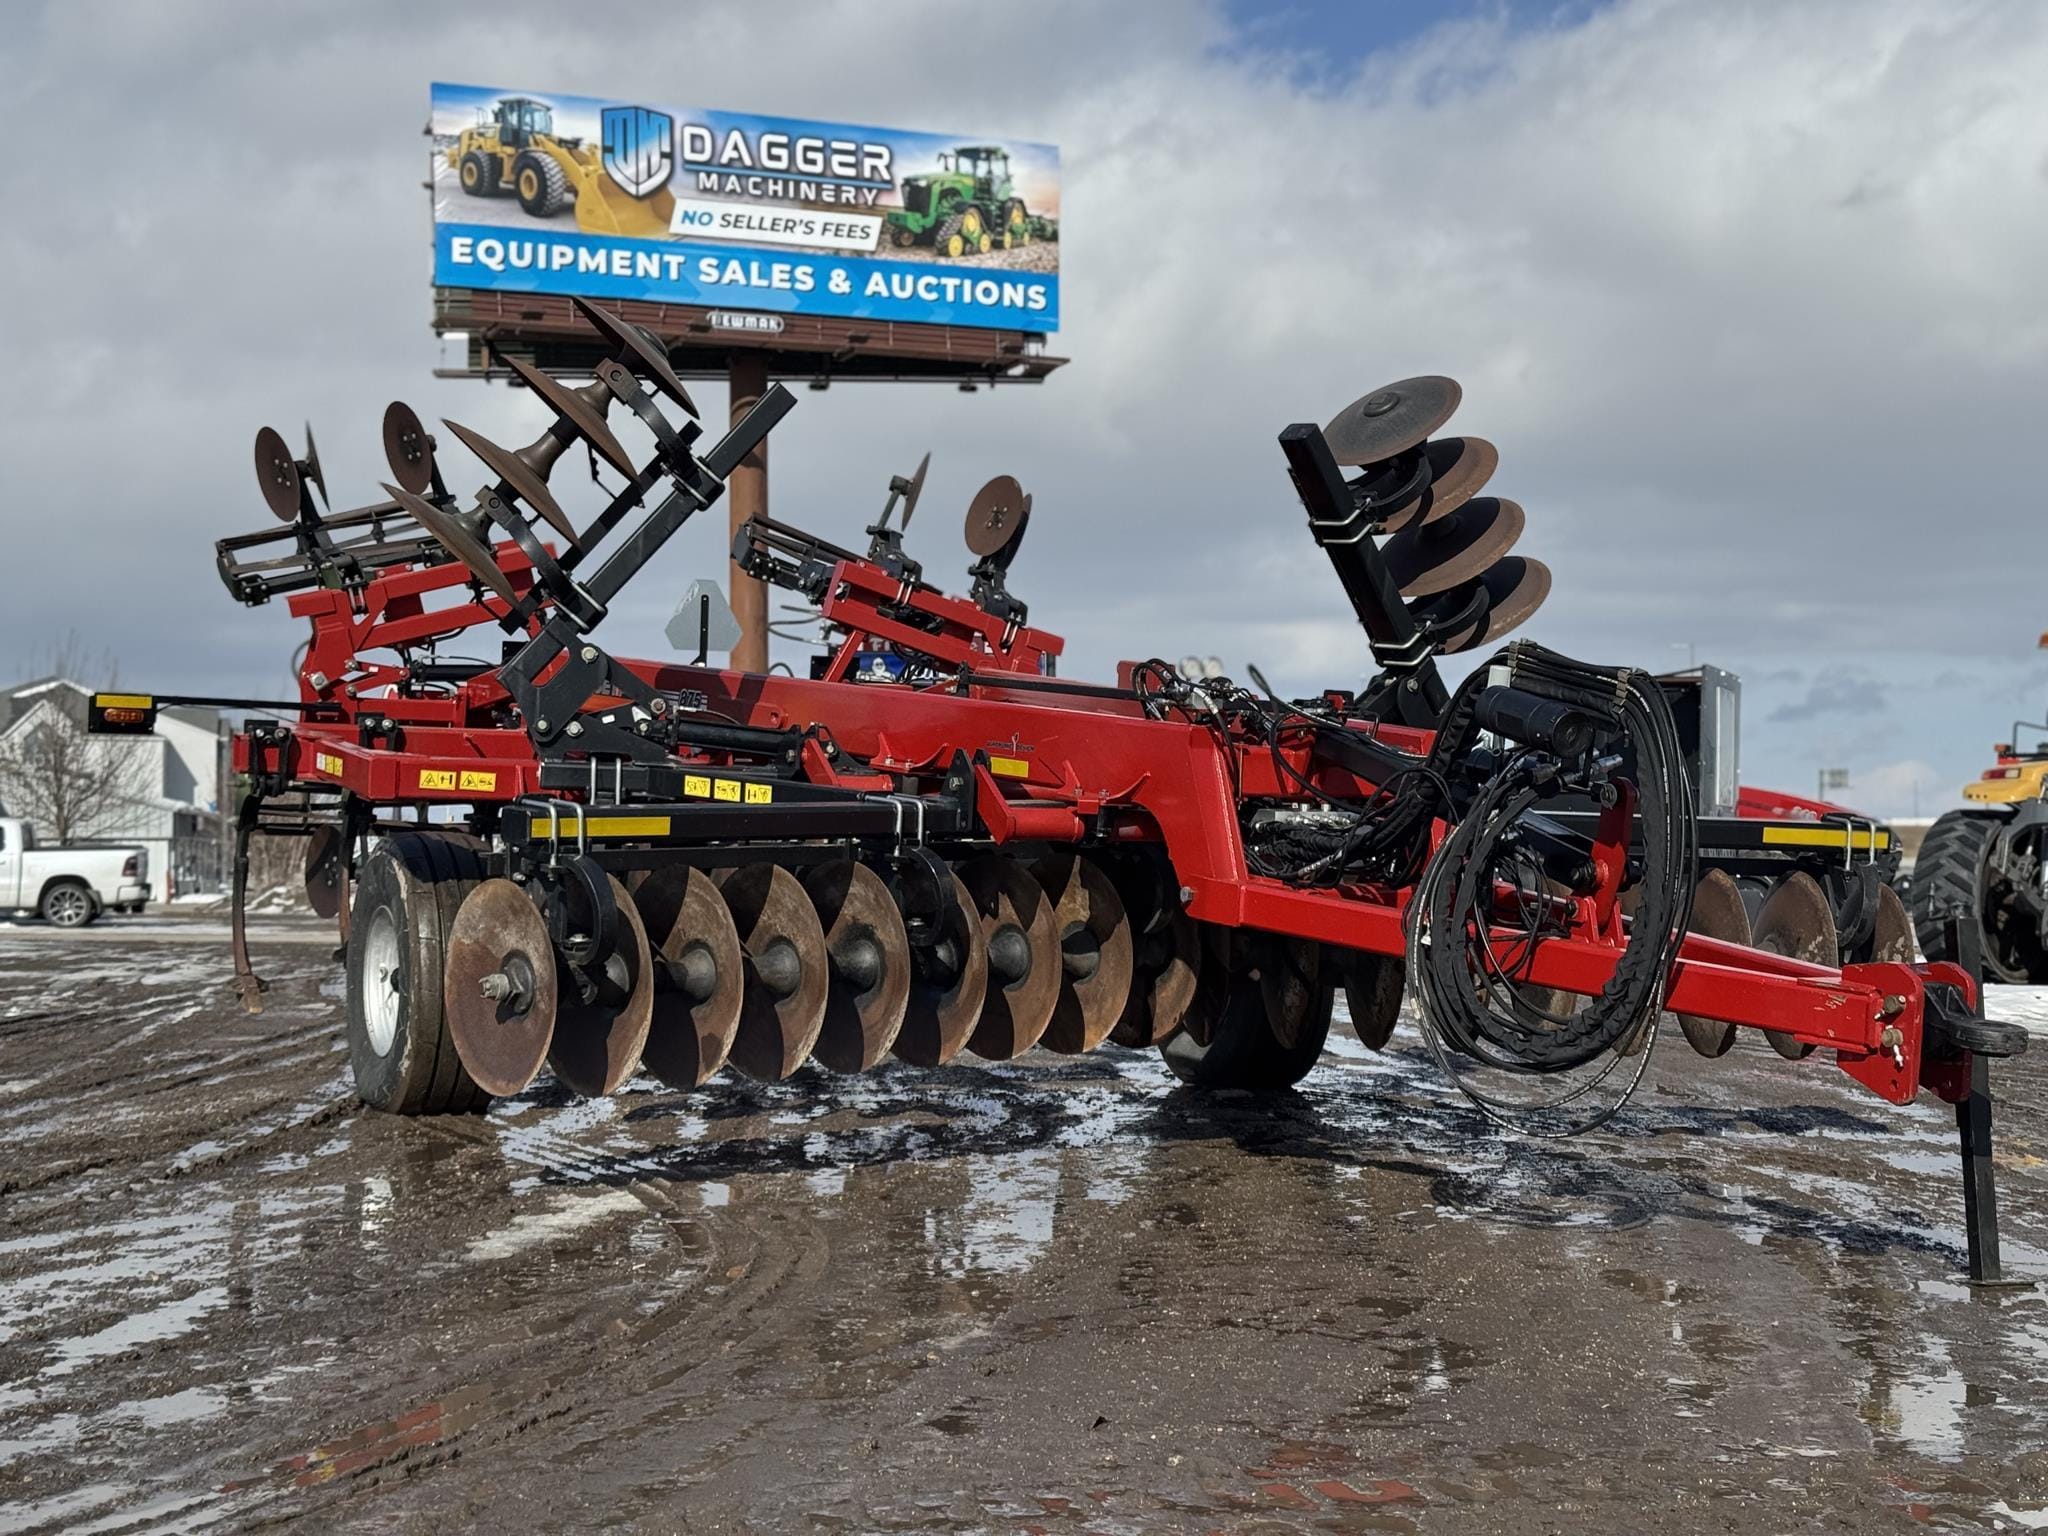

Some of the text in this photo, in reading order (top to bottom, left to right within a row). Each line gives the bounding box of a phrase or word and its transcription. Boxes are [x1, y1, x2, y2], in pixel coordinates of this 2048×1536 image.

[682, 125, 892, 181] DAGGER
[699, 171, 879, 206] MACHINERY
[681, 210, 872, 240] NO SELLER'S FEES
[451, 236, 1046, 310] EQUIPMENT SALES & AUCTIONS
[680, 688, 701, 708] 875
